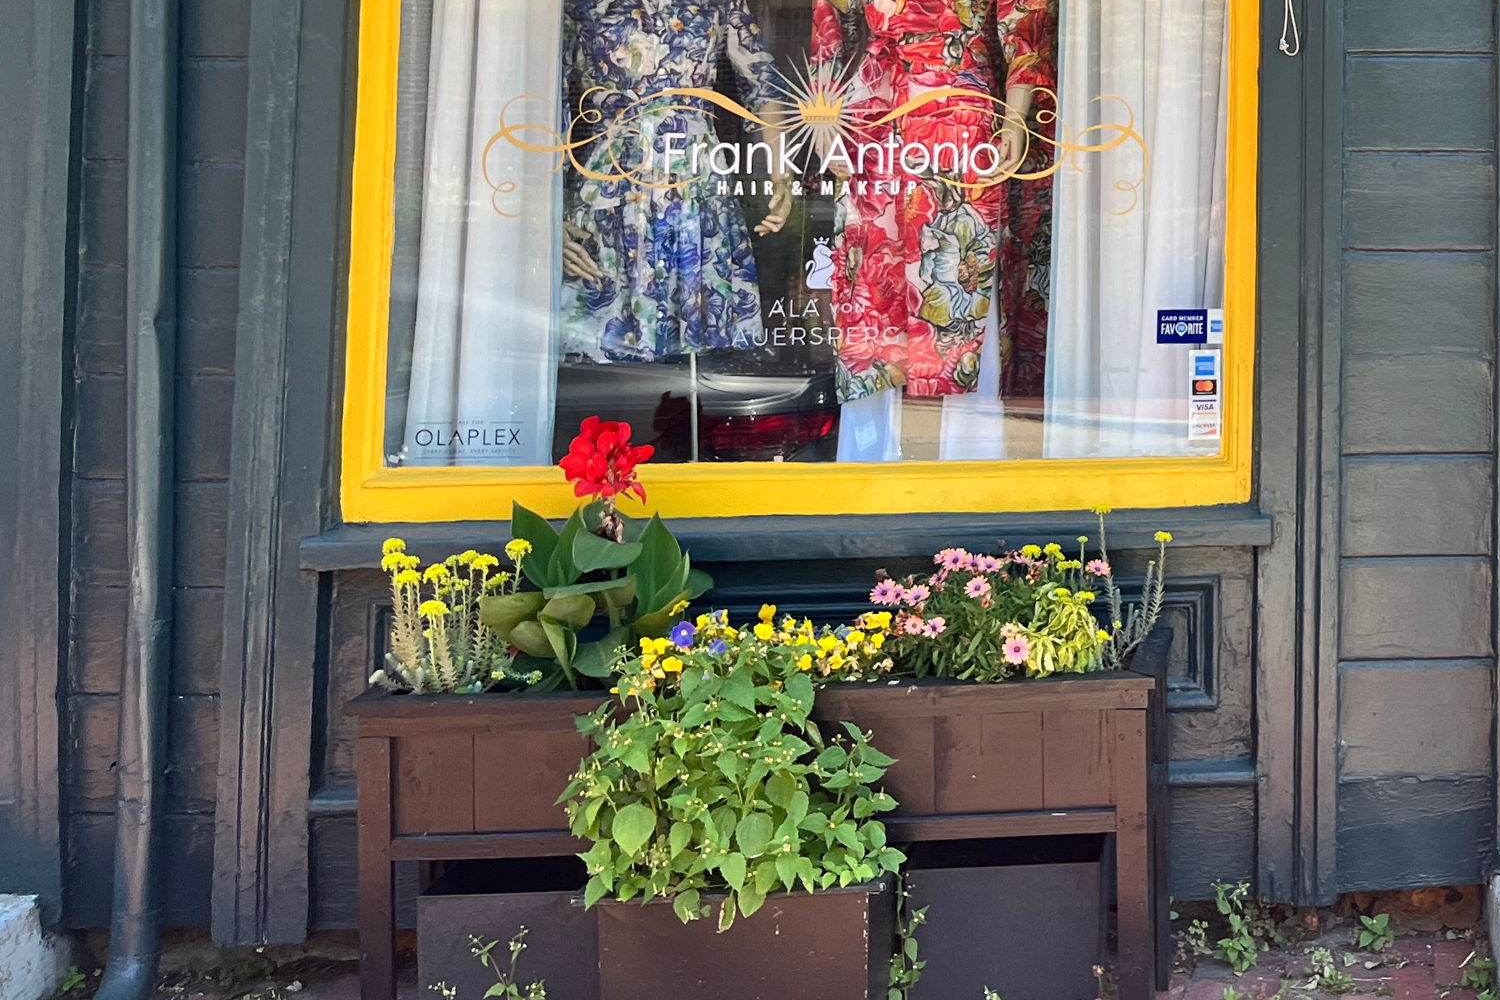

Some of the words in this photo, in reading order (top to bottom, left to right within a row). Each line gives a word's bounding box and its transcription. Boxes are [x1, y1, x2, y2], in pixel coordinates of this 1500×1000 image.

[663, 131, 803, 176] Frank
[819, 131, 1000, 176] Antonio
[716, 180, 774, 196] HAIR
[791, 180, 805, 196] &
[820, 180, 918, 197] MAKEUP
[768, 298, 820, 318] ALA
[829, 302, 866, 314] VON
[731, 326, 900, 347] AUERSPERG
[1196, 403, 1214, 411] VISA
[415, 428, 521, 447] OLAPLEX
